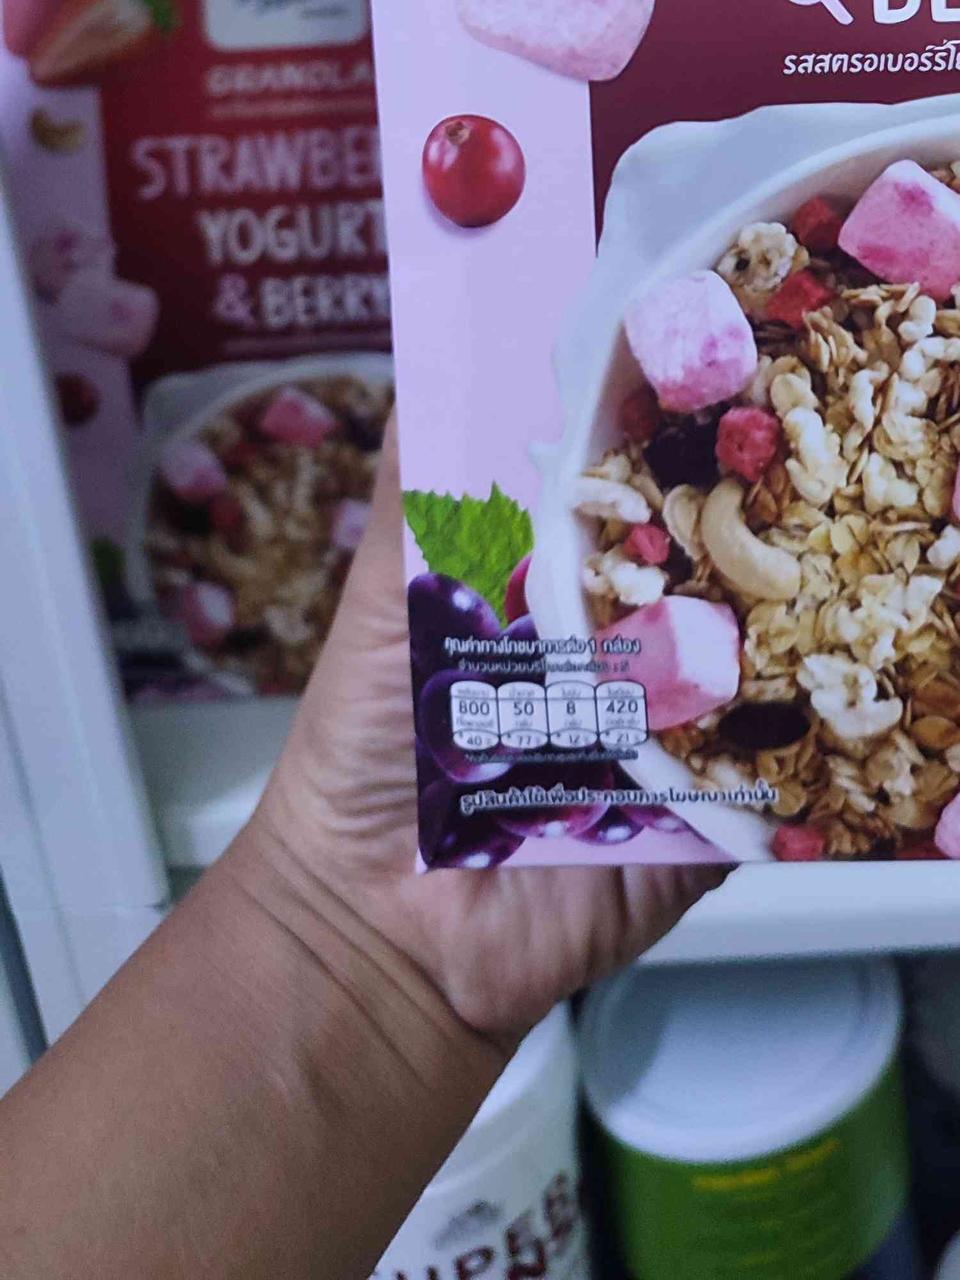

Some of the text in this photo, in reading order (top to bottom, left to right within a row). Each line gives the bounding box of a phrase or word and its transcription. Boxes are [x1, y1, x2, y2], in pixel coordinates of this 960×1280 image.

[458, 701, 490, 716] 800
[513, 701, 534, 716] 50
[606, 699, 638, 714] 420
